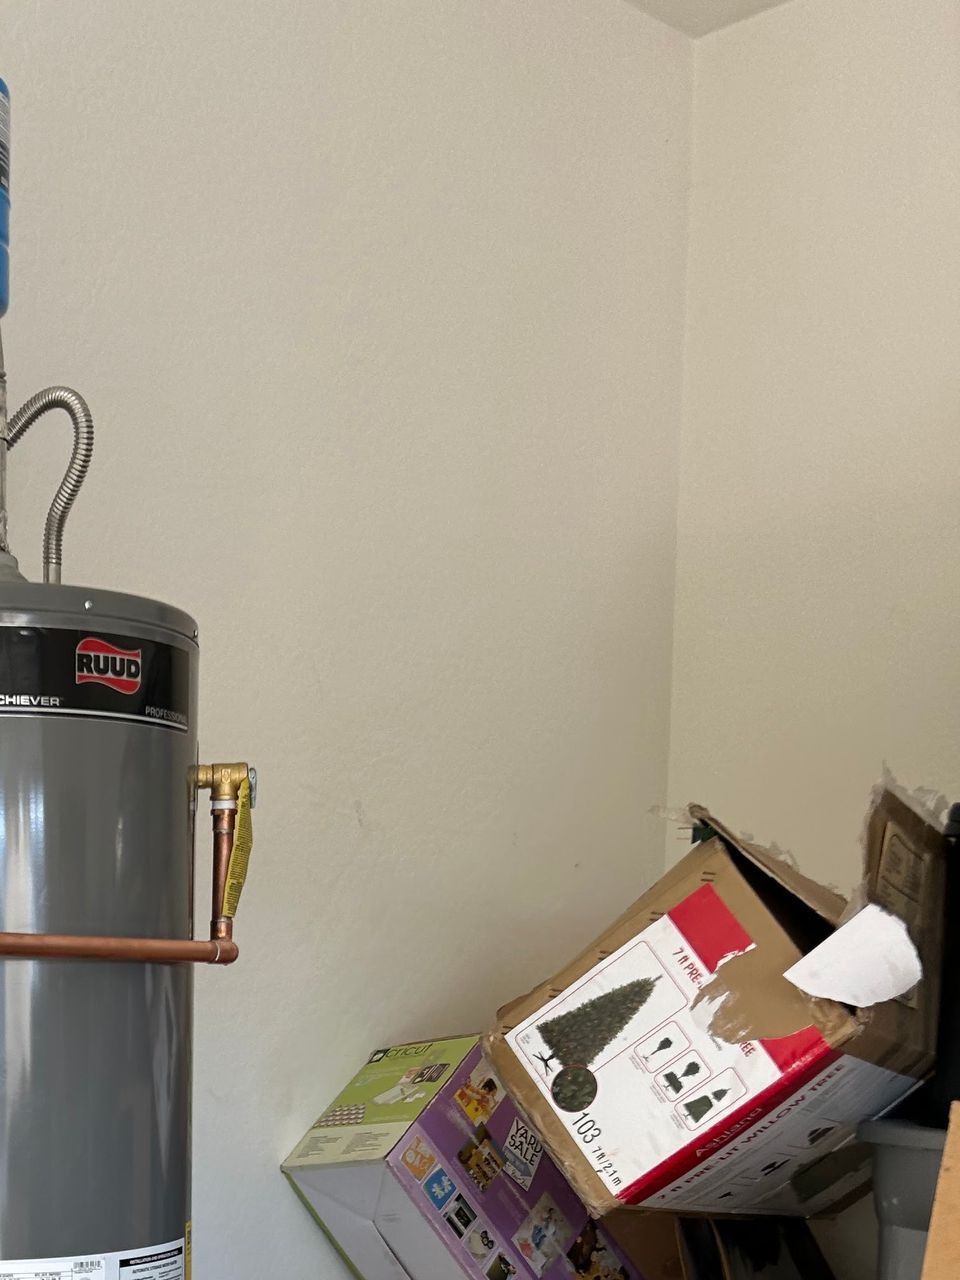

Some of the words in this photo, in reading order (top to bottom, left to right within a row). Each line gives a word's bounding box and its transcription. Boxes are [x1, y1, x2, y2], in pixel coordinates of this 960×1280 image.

[77, 653, 140, 679] RUUD
[145, 705, 188, 725] PROFESSIONAL
[673, 947, 684, 956] 7
[683, 962, 704, 990] PRE-
[385, 1043, 433, 1057] cricut
[741, 1094, 806, 1144] WILLOW
[808, 1064, 845, 1092] TREE
[572, 1112, 602, 1144] 103
[695, 1107, 763, 1157] Ashland
[509, 1135, 538, 1166] SALE
